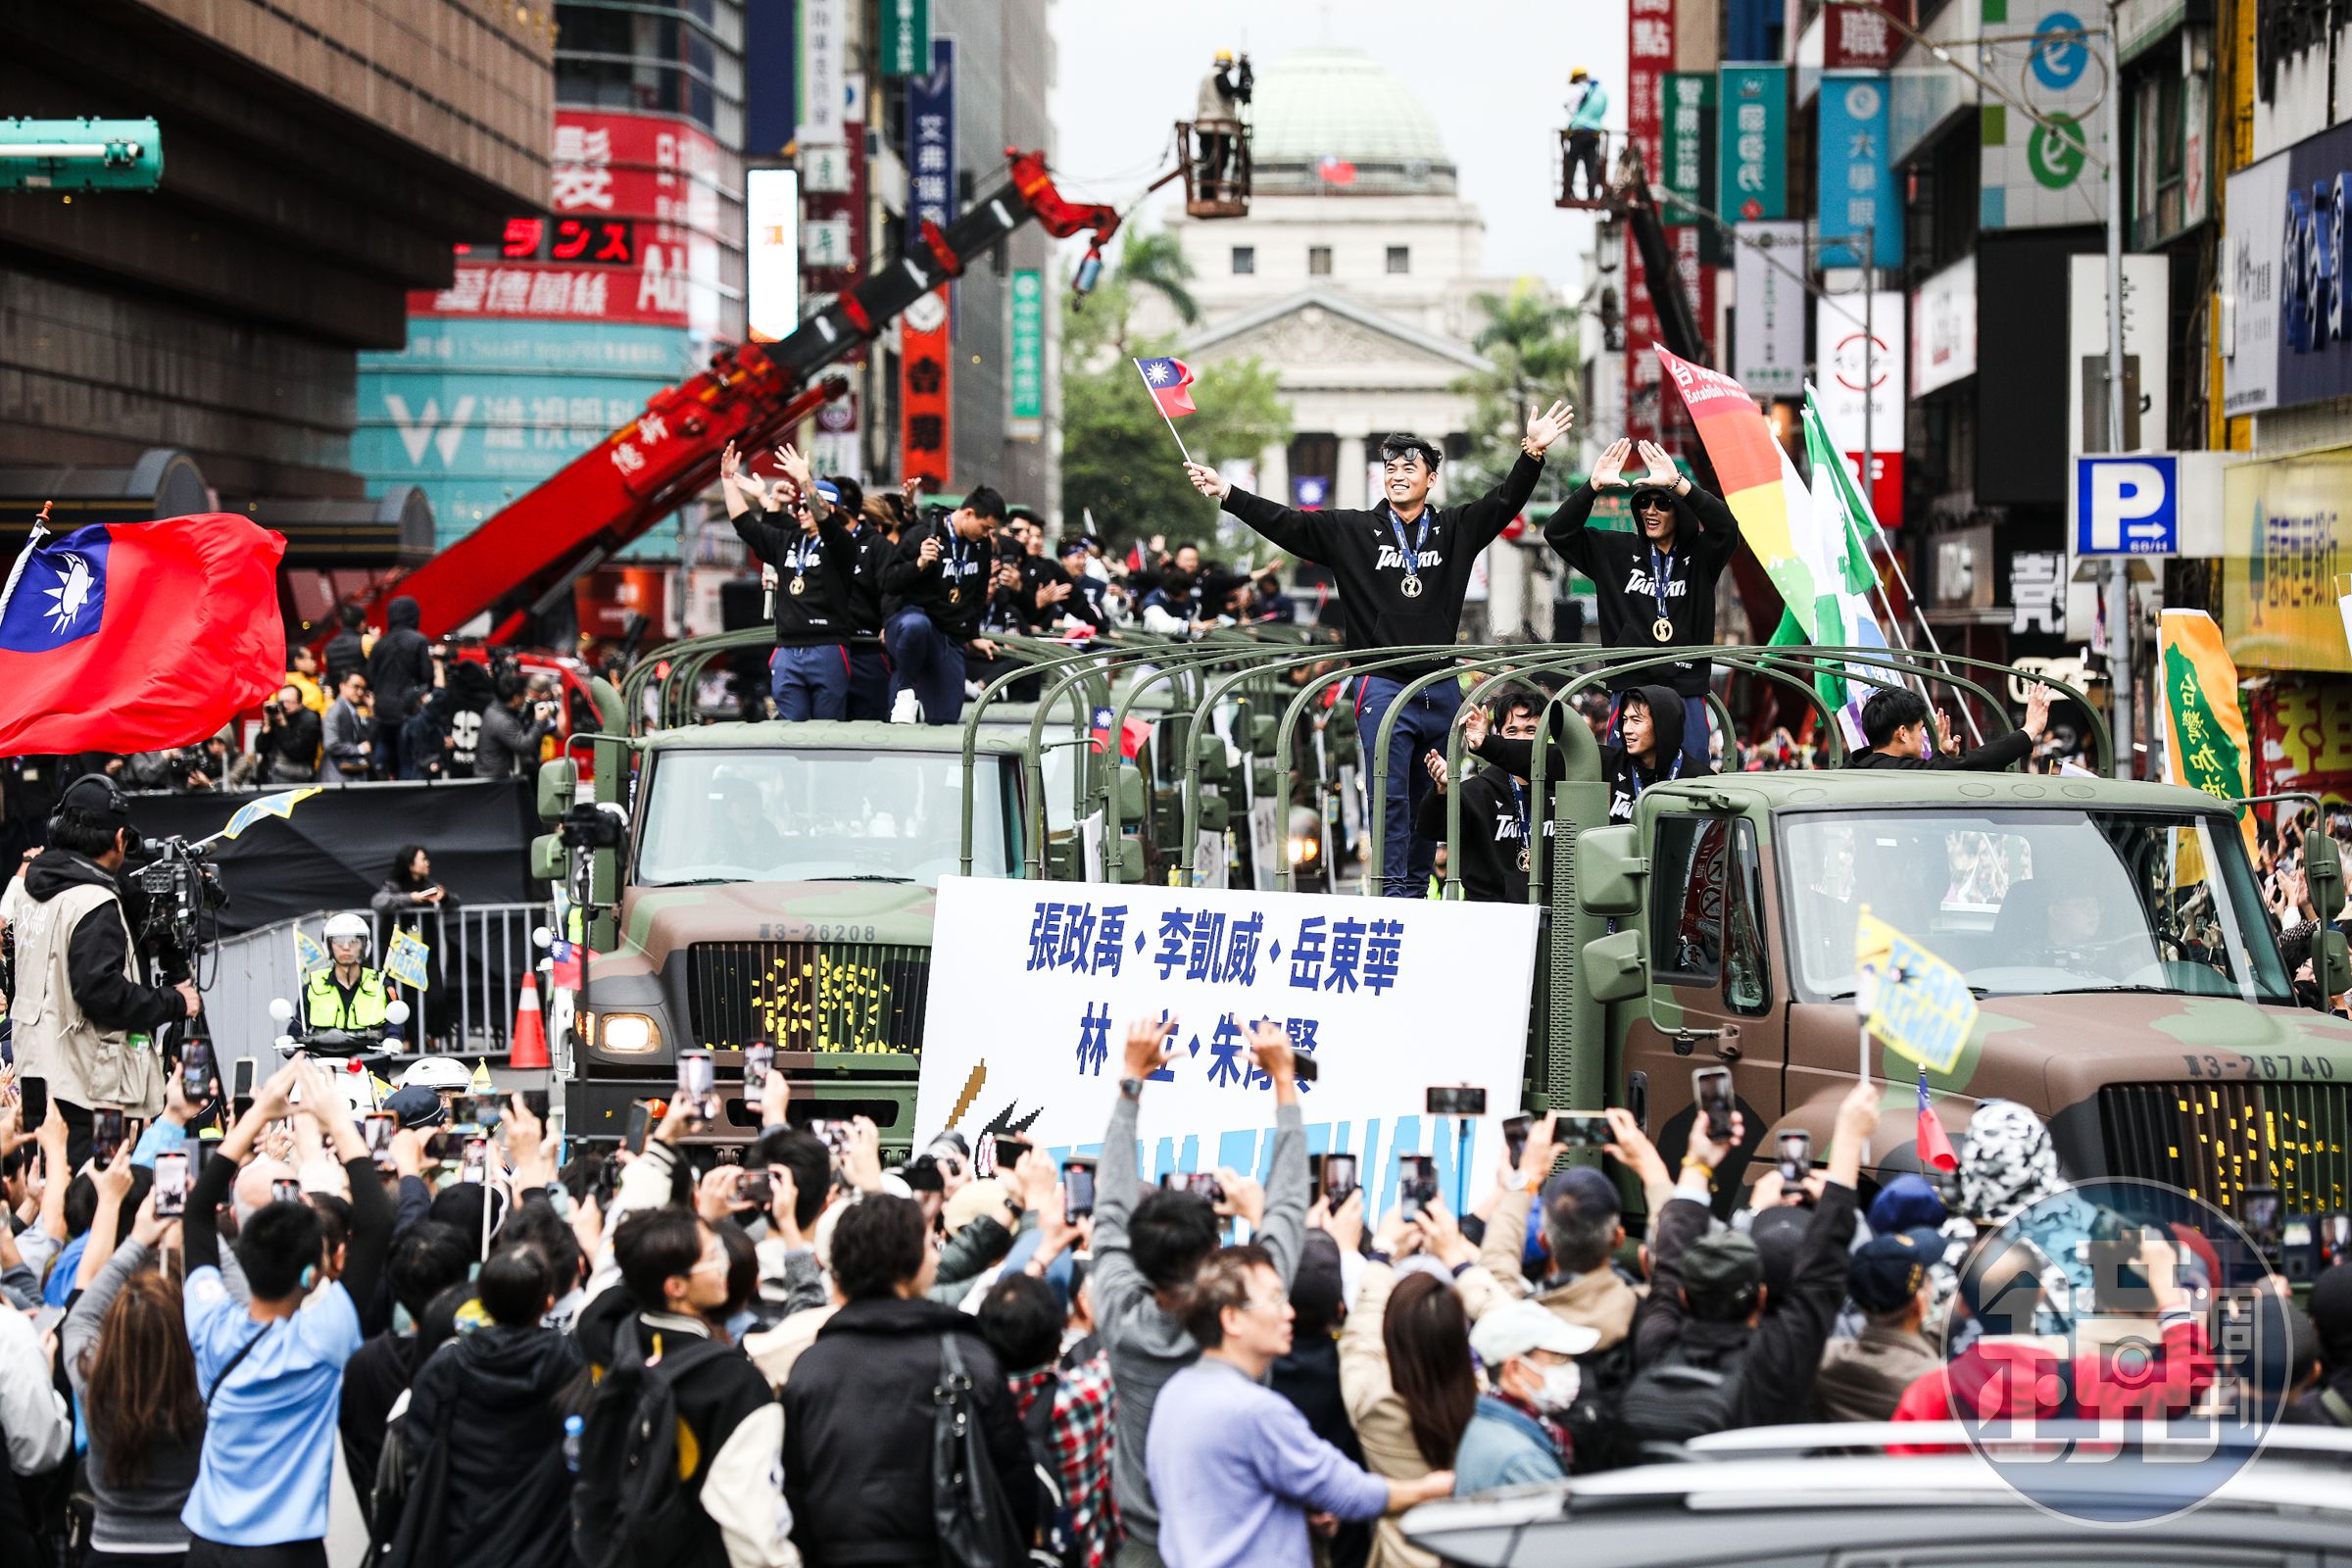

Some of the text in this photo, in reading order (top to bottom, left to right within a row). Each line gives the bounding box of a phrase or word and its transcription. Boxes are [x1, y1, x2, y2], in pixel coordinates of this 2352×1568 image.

[2091, 463, 2166, 550] P
[1375, 545, 1443, 570] Taian
[1624, 568, 1687, 597] Taian
[1027, 903, 1404, 997] 張政禹 李凱威 岳東華
